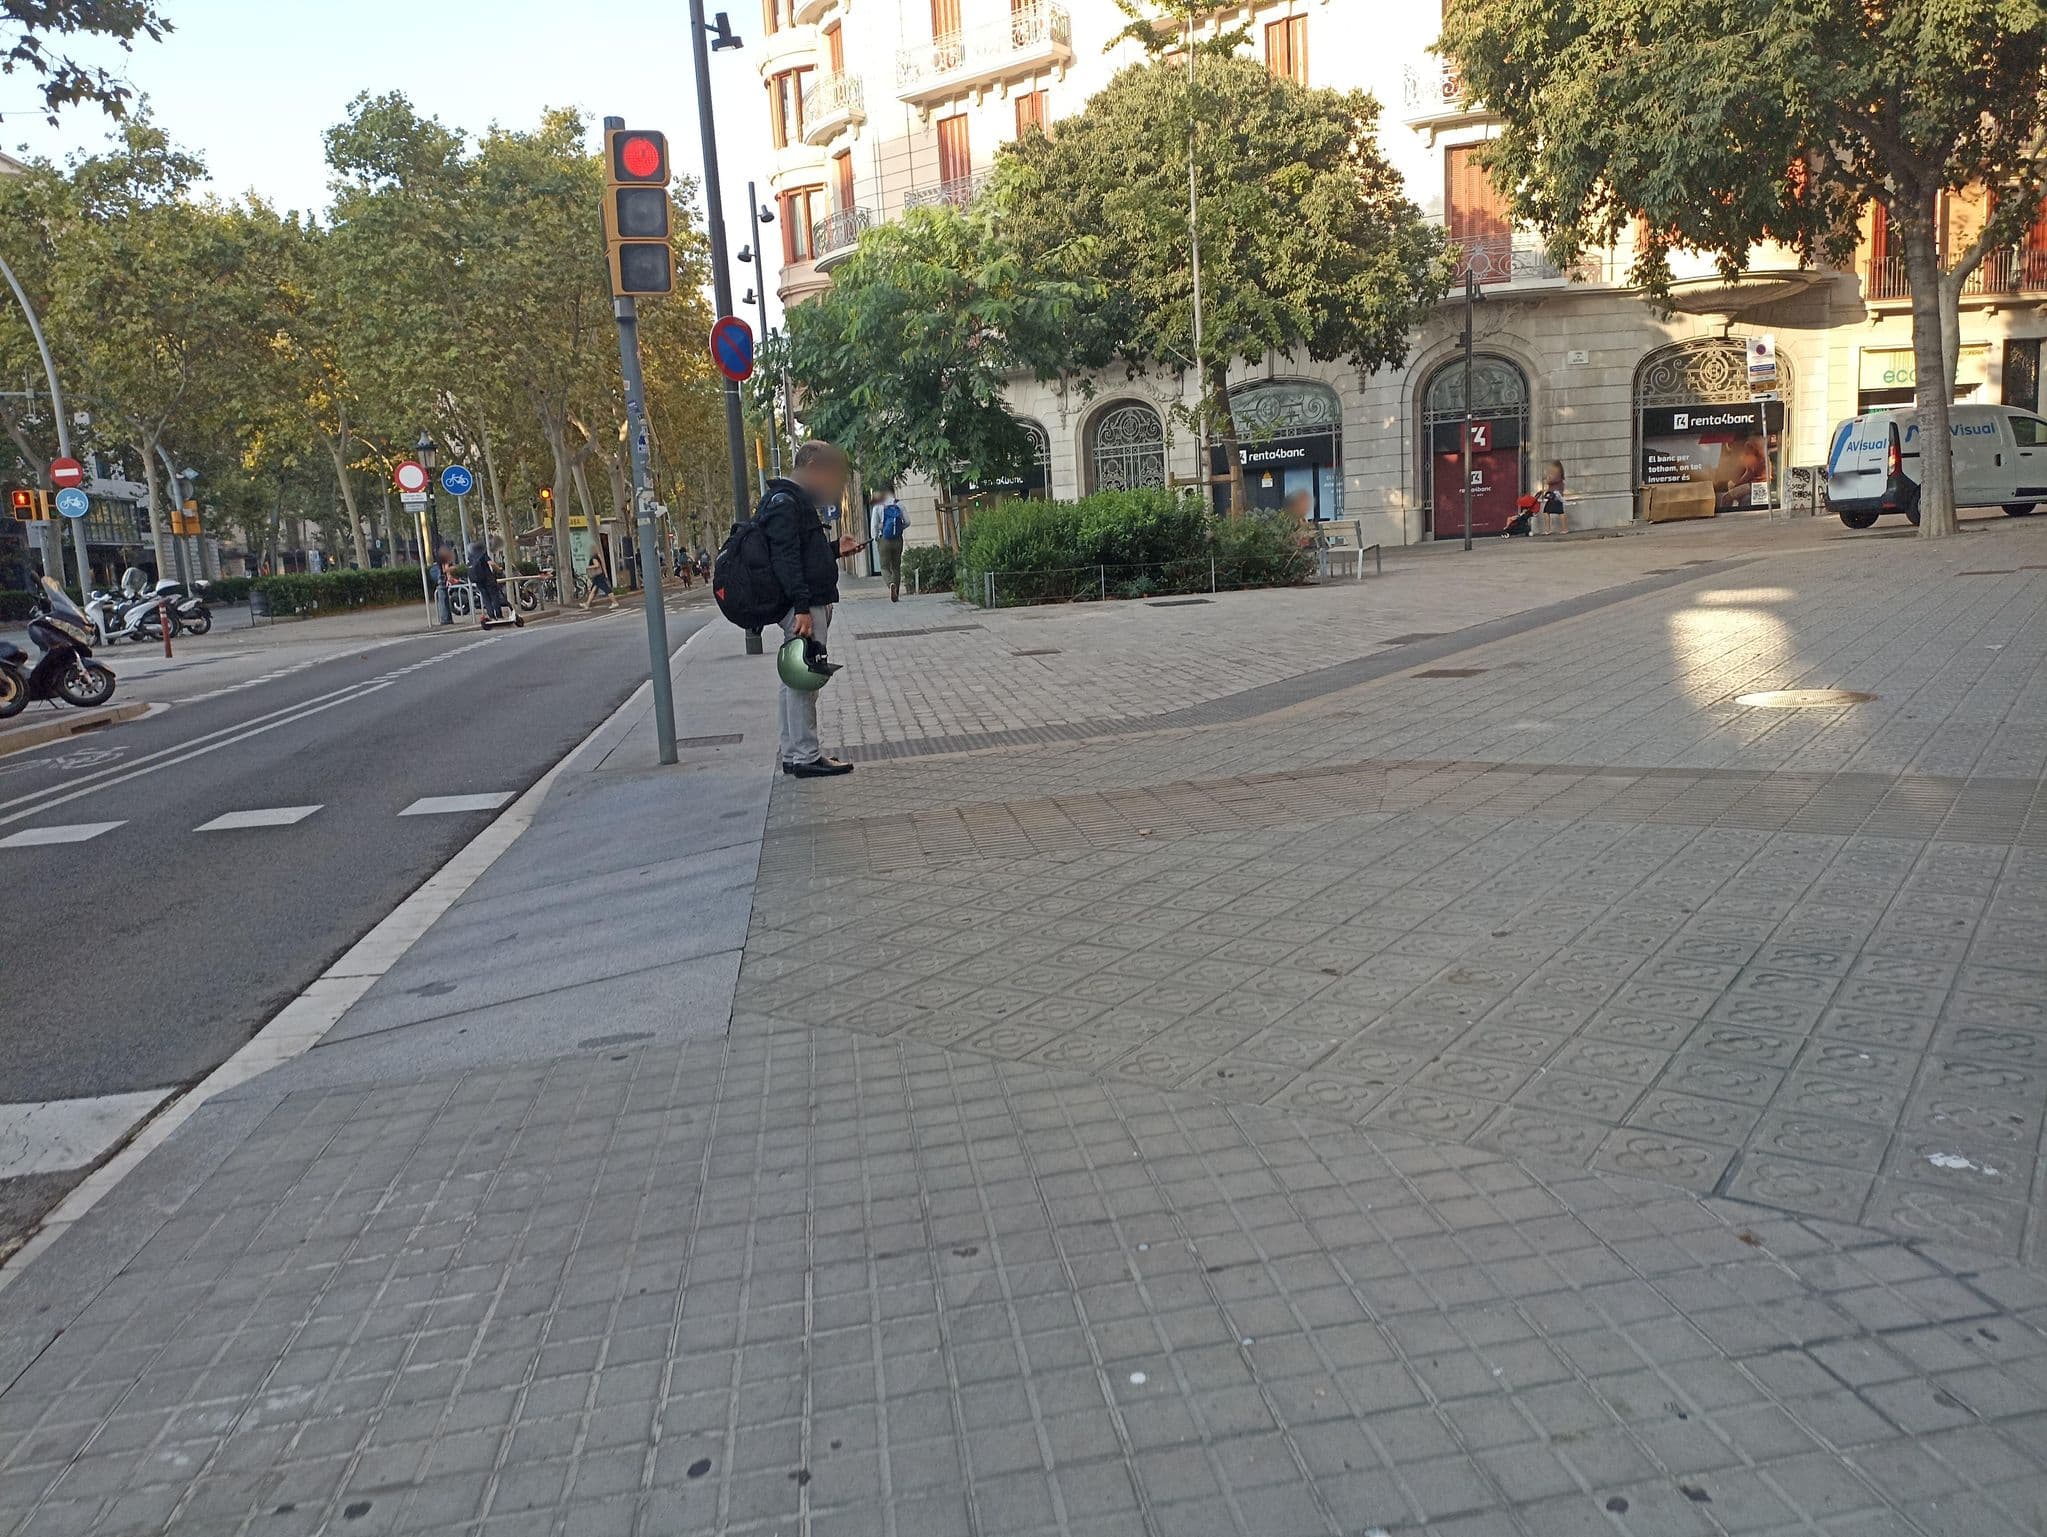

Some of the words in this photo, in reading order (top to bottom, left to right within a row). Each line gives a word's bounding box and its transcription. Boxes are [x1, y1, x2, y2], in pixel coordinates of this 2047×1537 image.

[1690, 413, 1755, 426] renta4banc
[1846, 438, 1887, 452] AVisual
[1248, 448, 1305, 462] renta4banc
[1677, 455, 1690, 463] per
[1649, 475, 1680, 483] inversor
